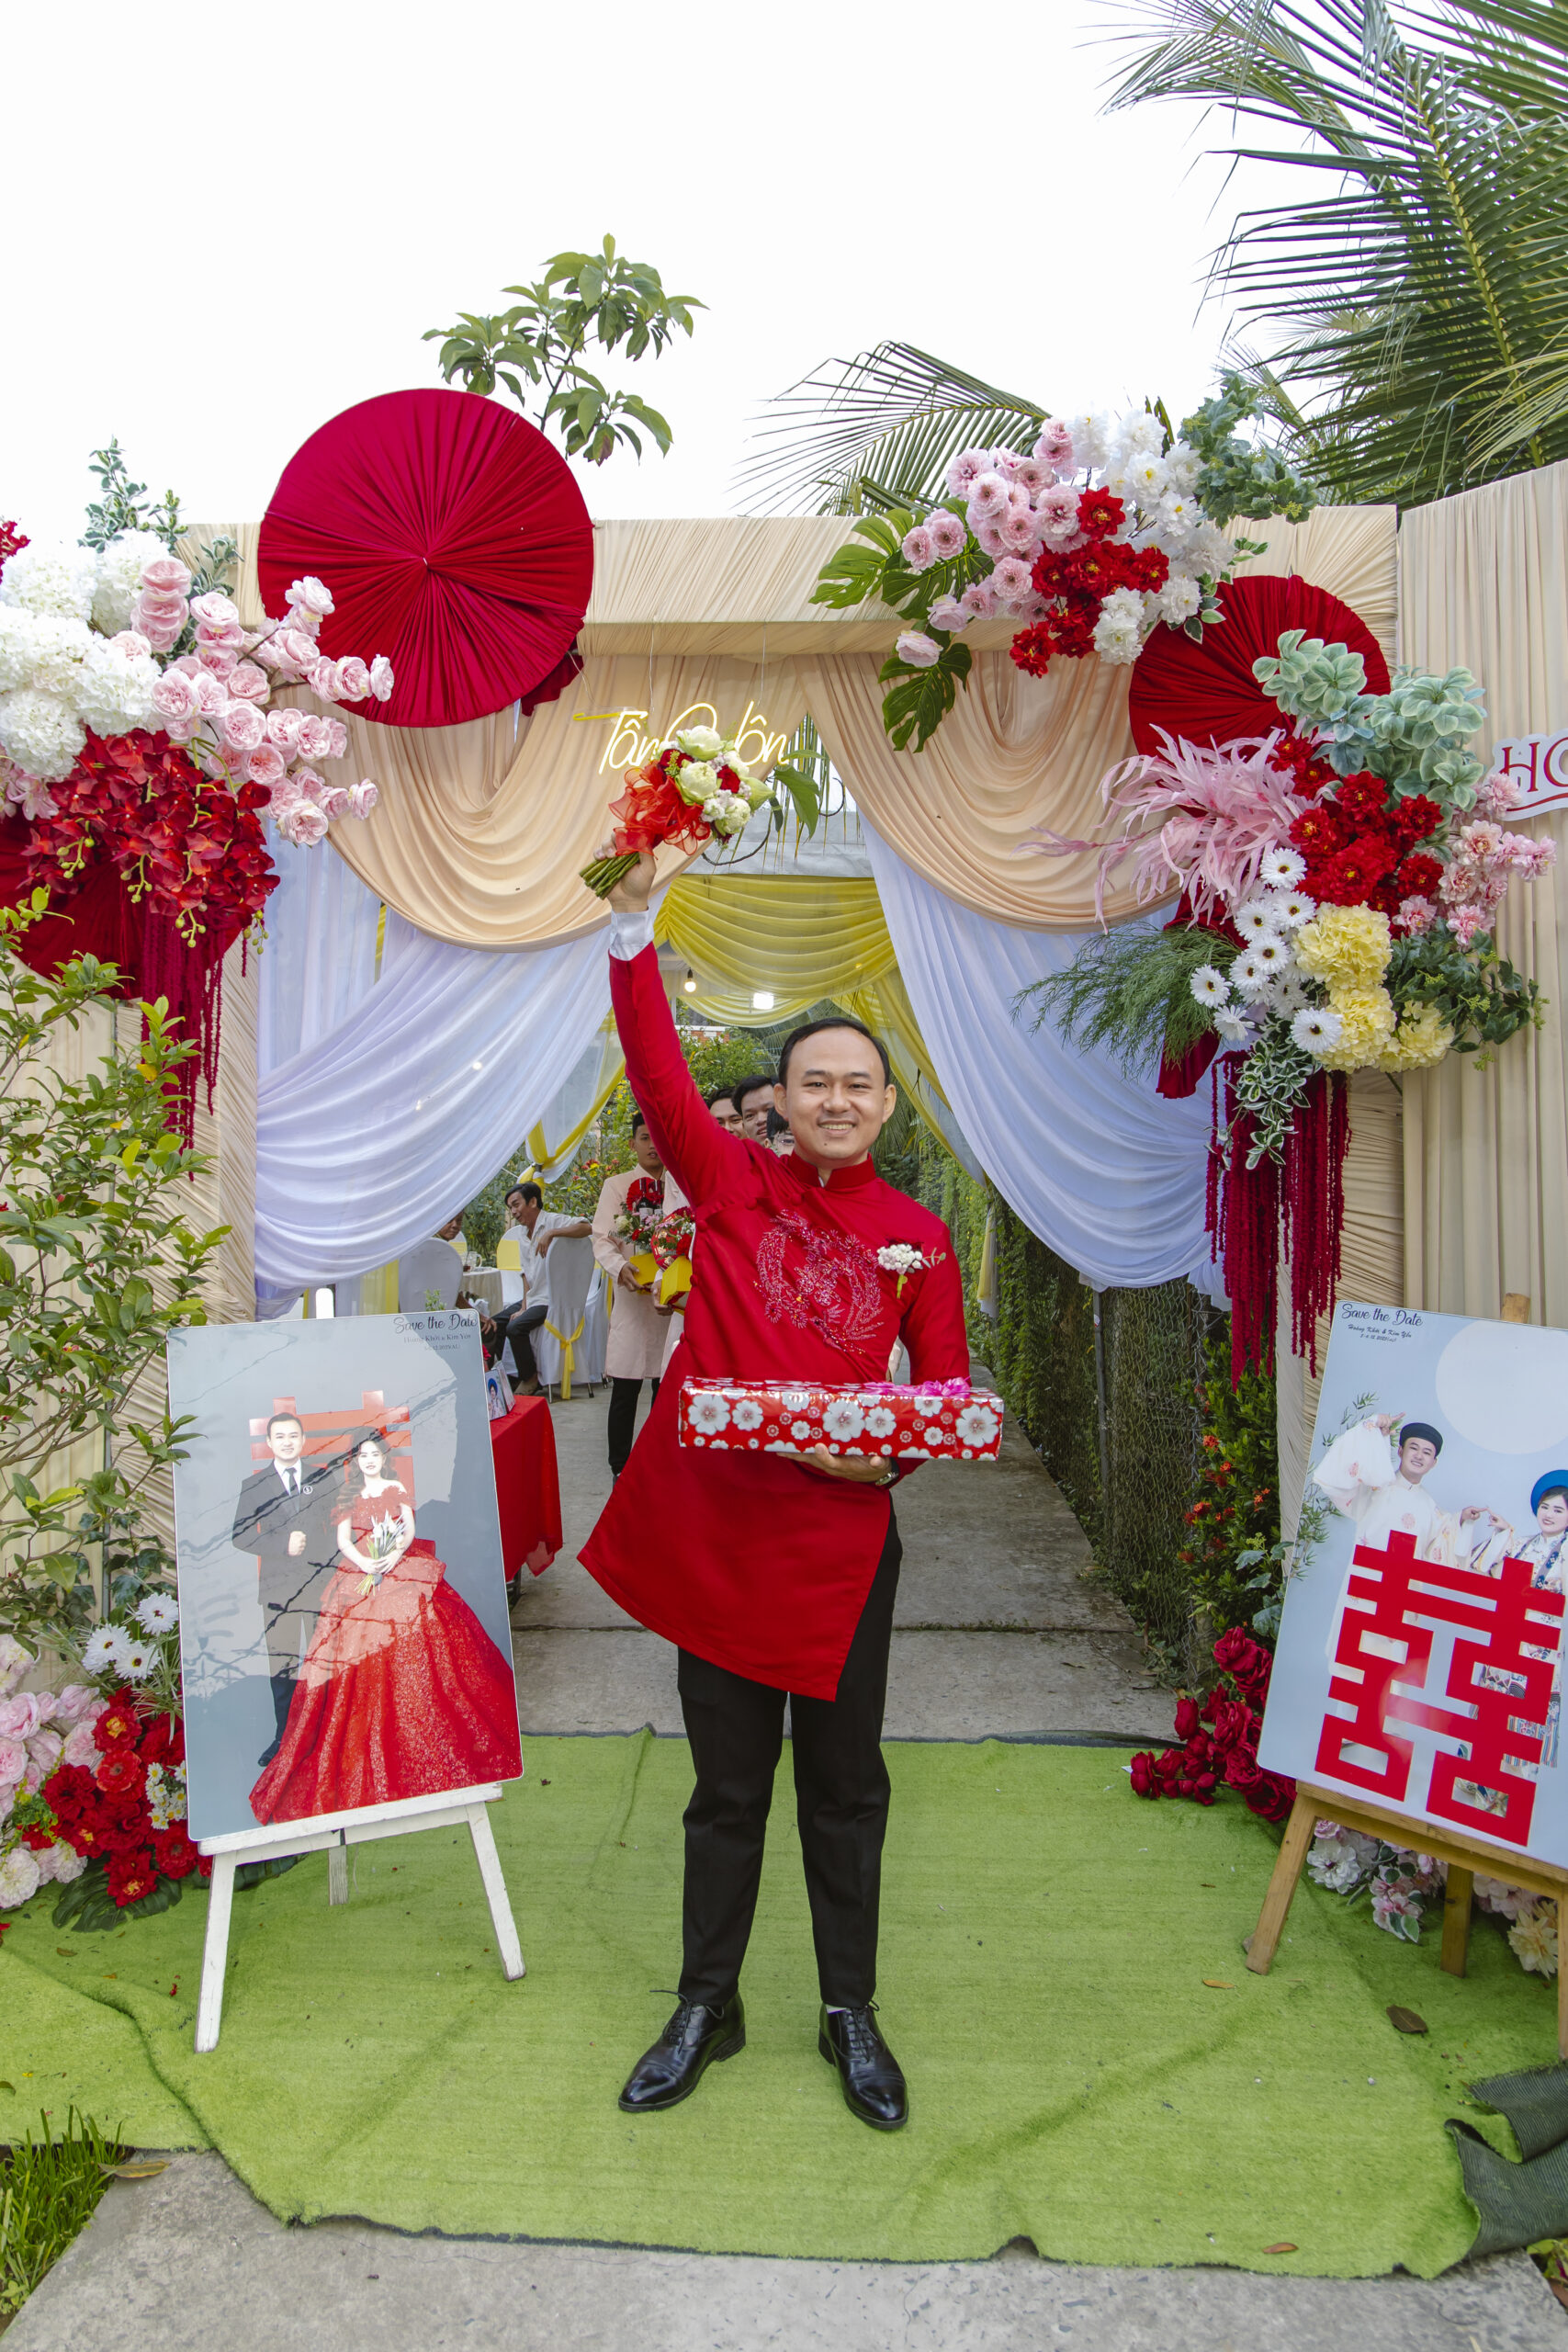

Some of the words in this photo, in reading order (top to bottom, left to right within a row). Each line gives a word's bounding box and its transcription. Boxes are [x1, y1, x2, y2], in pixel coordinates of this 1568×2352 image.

[393, 1317, 424, 1334] Save
[427, 1316, 446, 1330] the
[448, 1313, 478, 1331] Date
[1341, 1303, 1371, 1320] Save
[1372, 1307, 1391, 1322] the
[1392, 1309, 1424, 1327] Date
